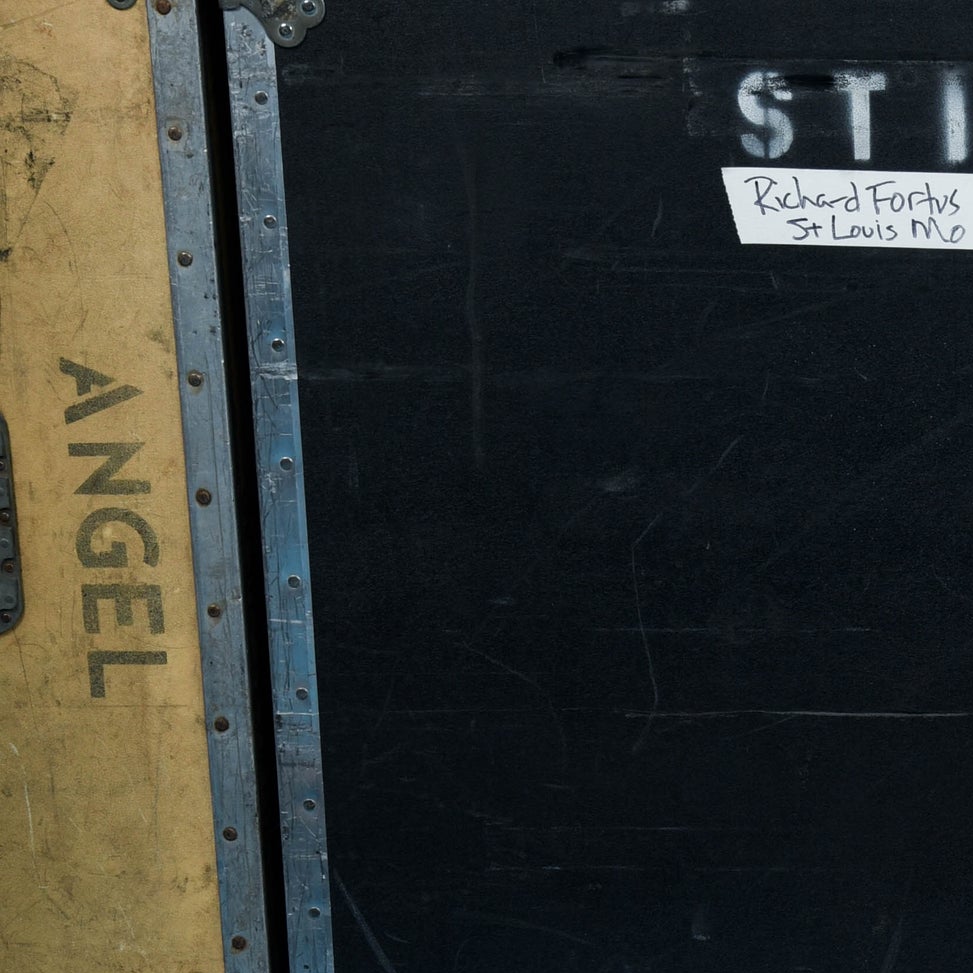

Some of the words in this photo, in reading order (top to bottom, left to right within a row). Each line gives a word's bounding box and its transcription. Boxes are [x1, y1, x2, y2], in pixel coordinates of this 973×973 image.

[744, 175, 861, 216] Richard
[864, 180, 962, 216] Fortus
[785, 217, 823, 241] St
[831, 215, 899, 242] Louis
[911, 218, 967, 244] Mo
[58, 356, 168, 699] ANGEL
